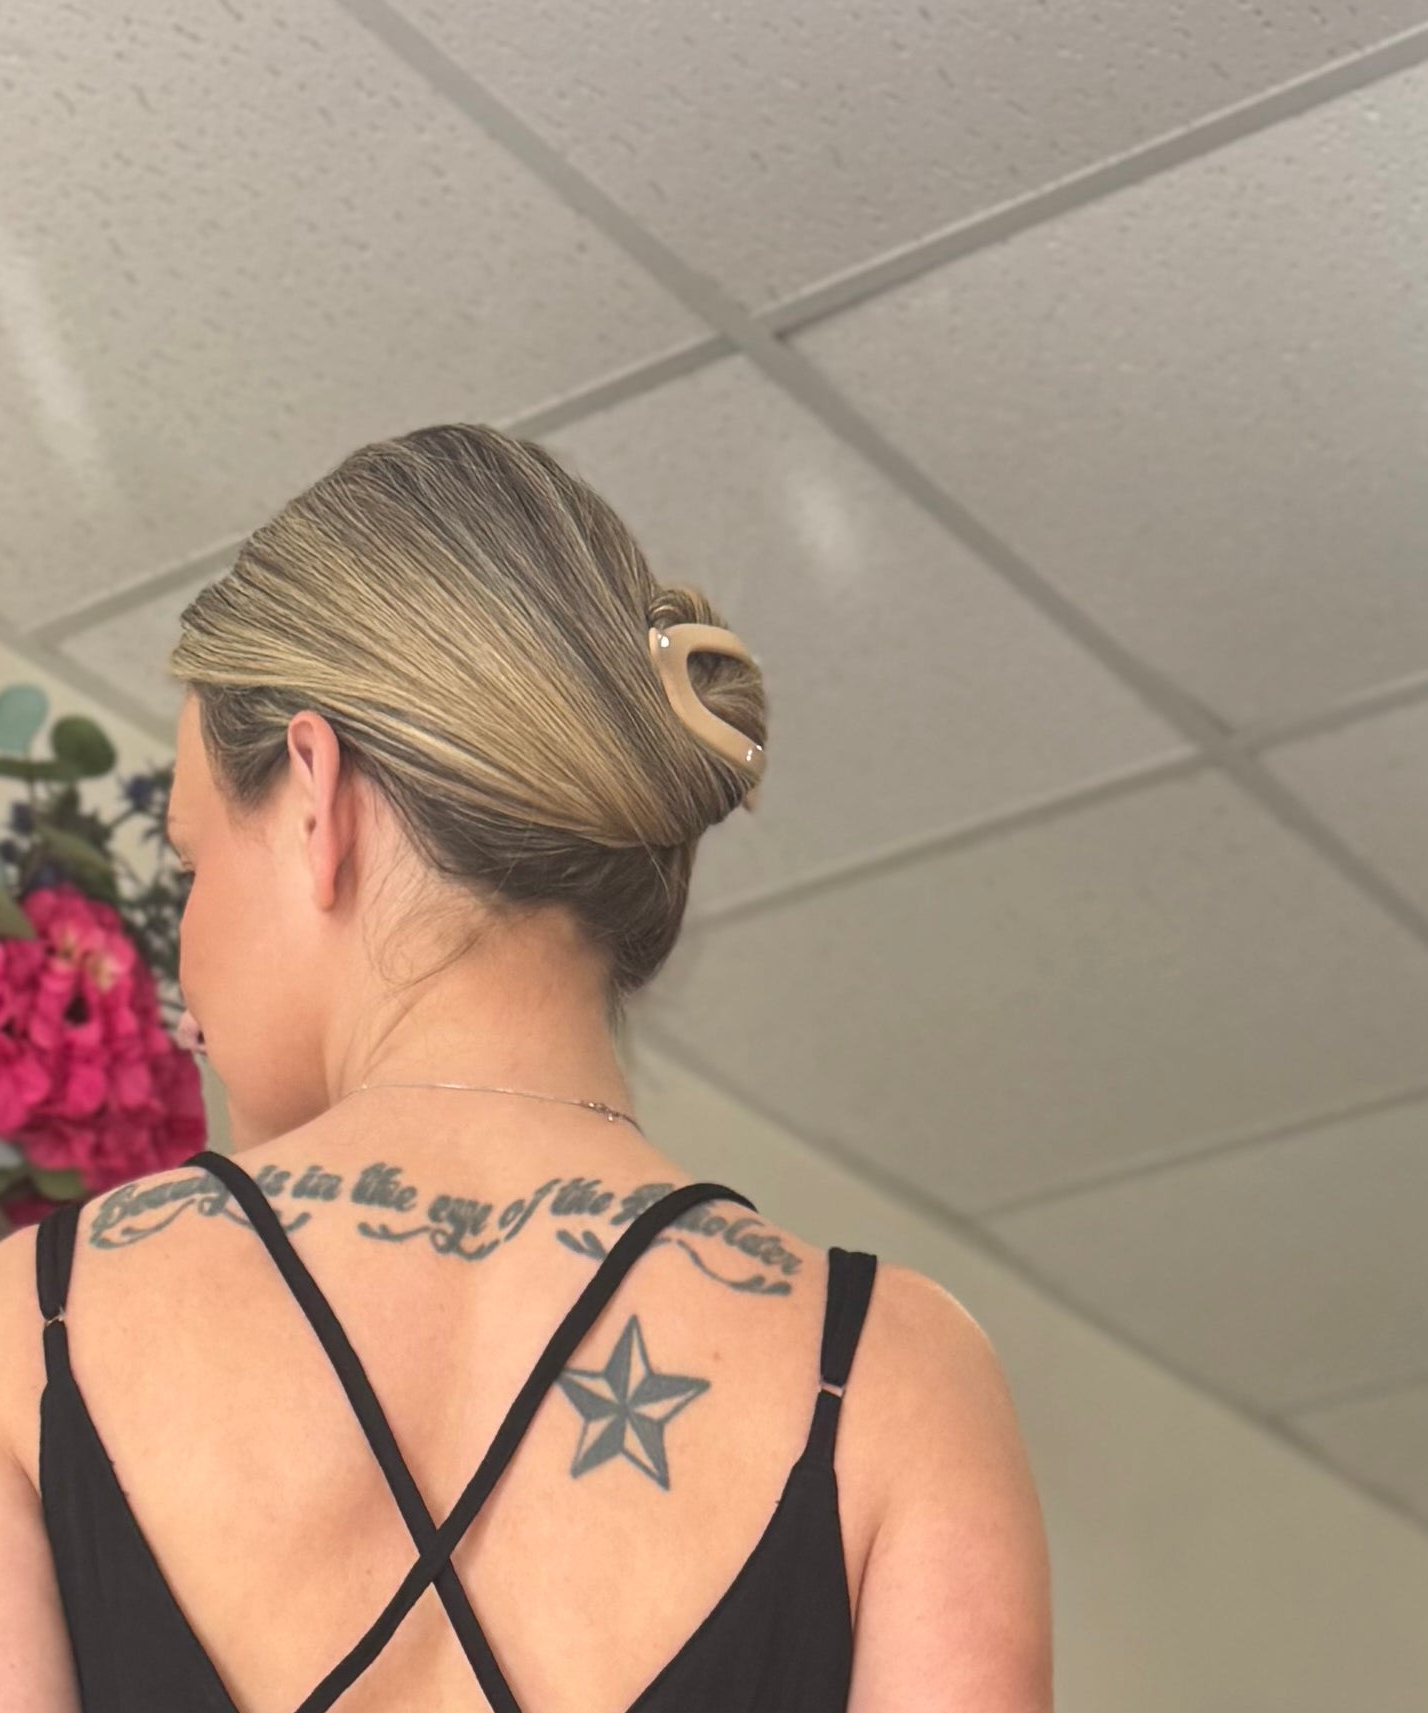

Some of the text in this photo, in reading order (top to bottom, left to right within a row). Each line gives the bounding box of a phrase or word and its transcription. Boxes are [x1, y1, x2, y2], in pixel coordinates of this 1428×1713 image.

[292, 1165, 342, 1201] in
[351, 1162, 418, 1212] the
[428, 1195, 499, 1261] eye
[498, 1178, 562, 1242] of
[550, 1178, 615, 1216] the
